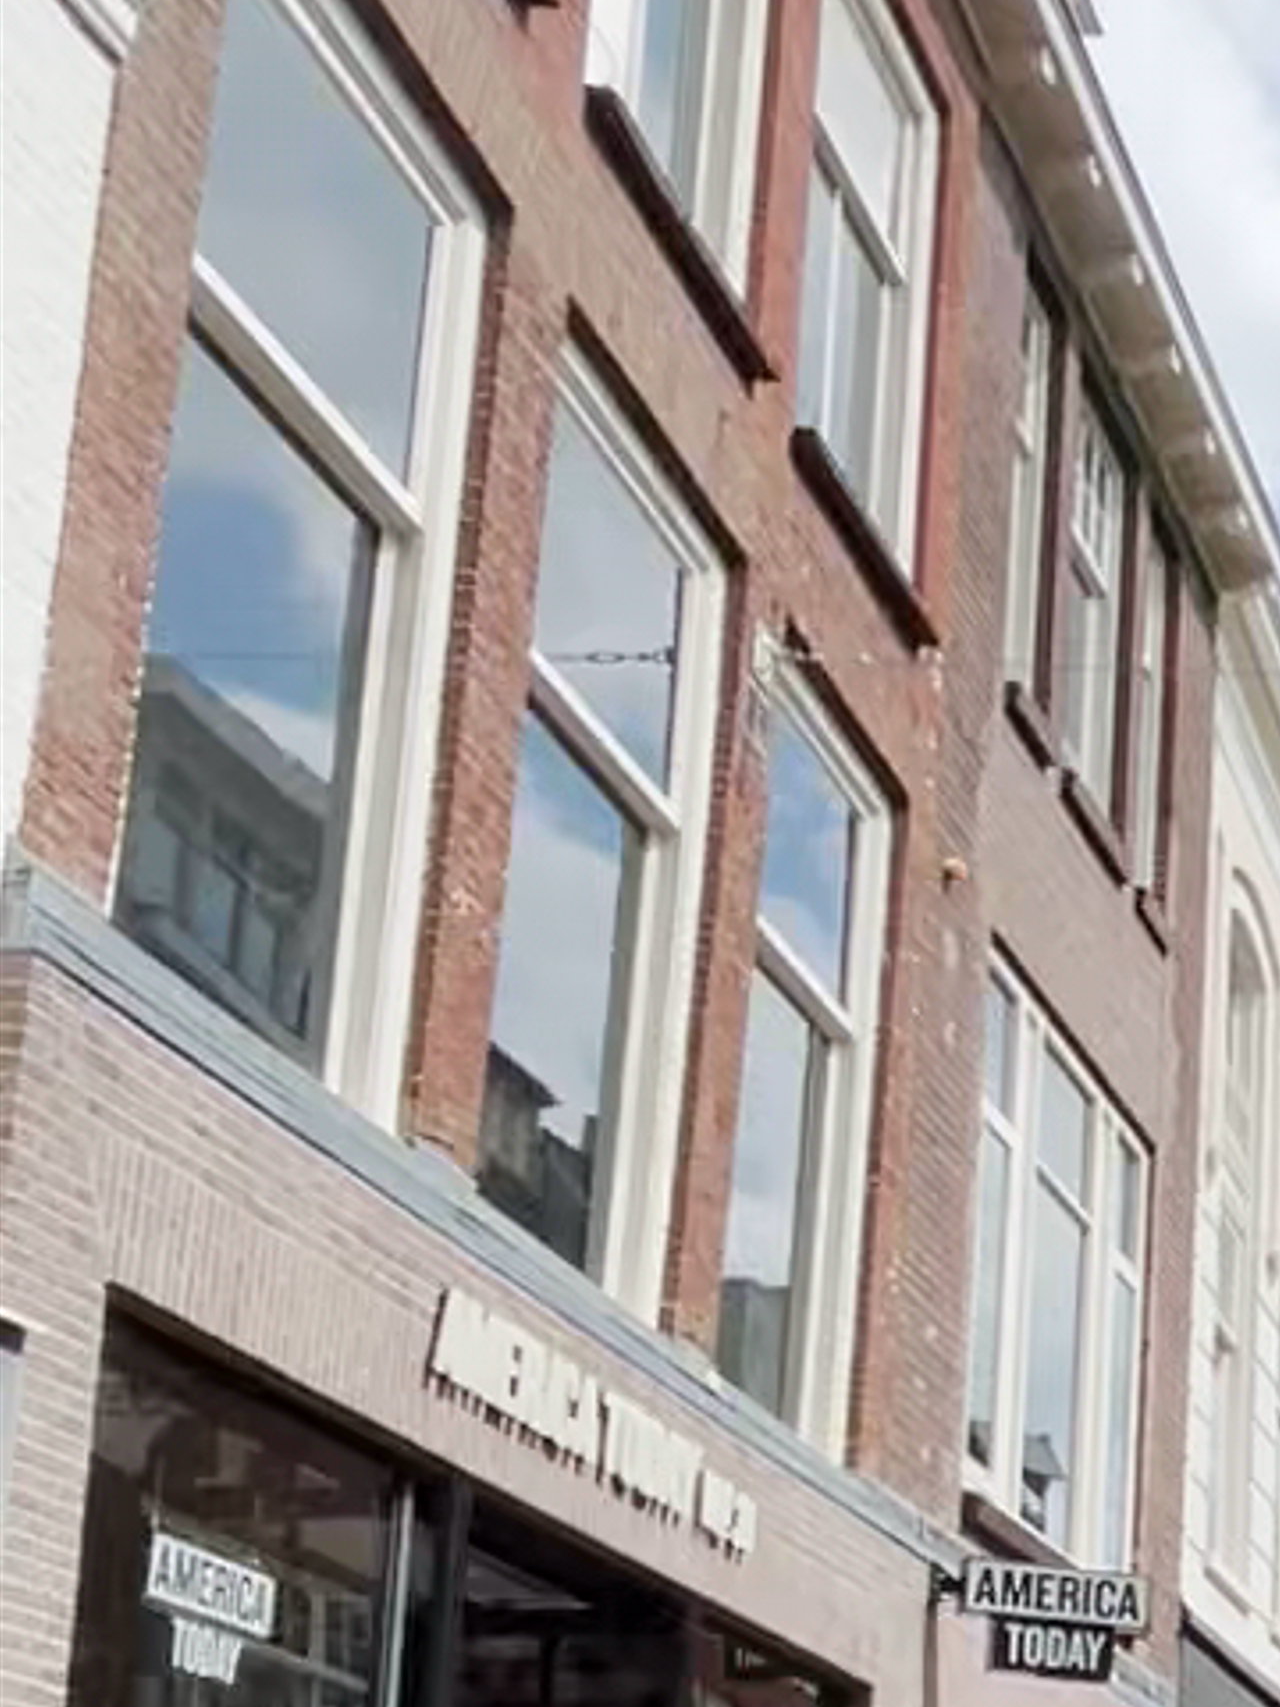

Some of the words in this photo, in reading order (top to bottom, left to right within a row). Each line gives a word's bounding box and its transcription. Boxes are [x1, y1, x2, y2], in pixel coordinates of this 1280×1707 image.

[154, 1541, 267, 1628] AMERICA
[974, 1566, 1138, 1620] AMERICA
[1004, 1623, 1106, 1672] TODAY
